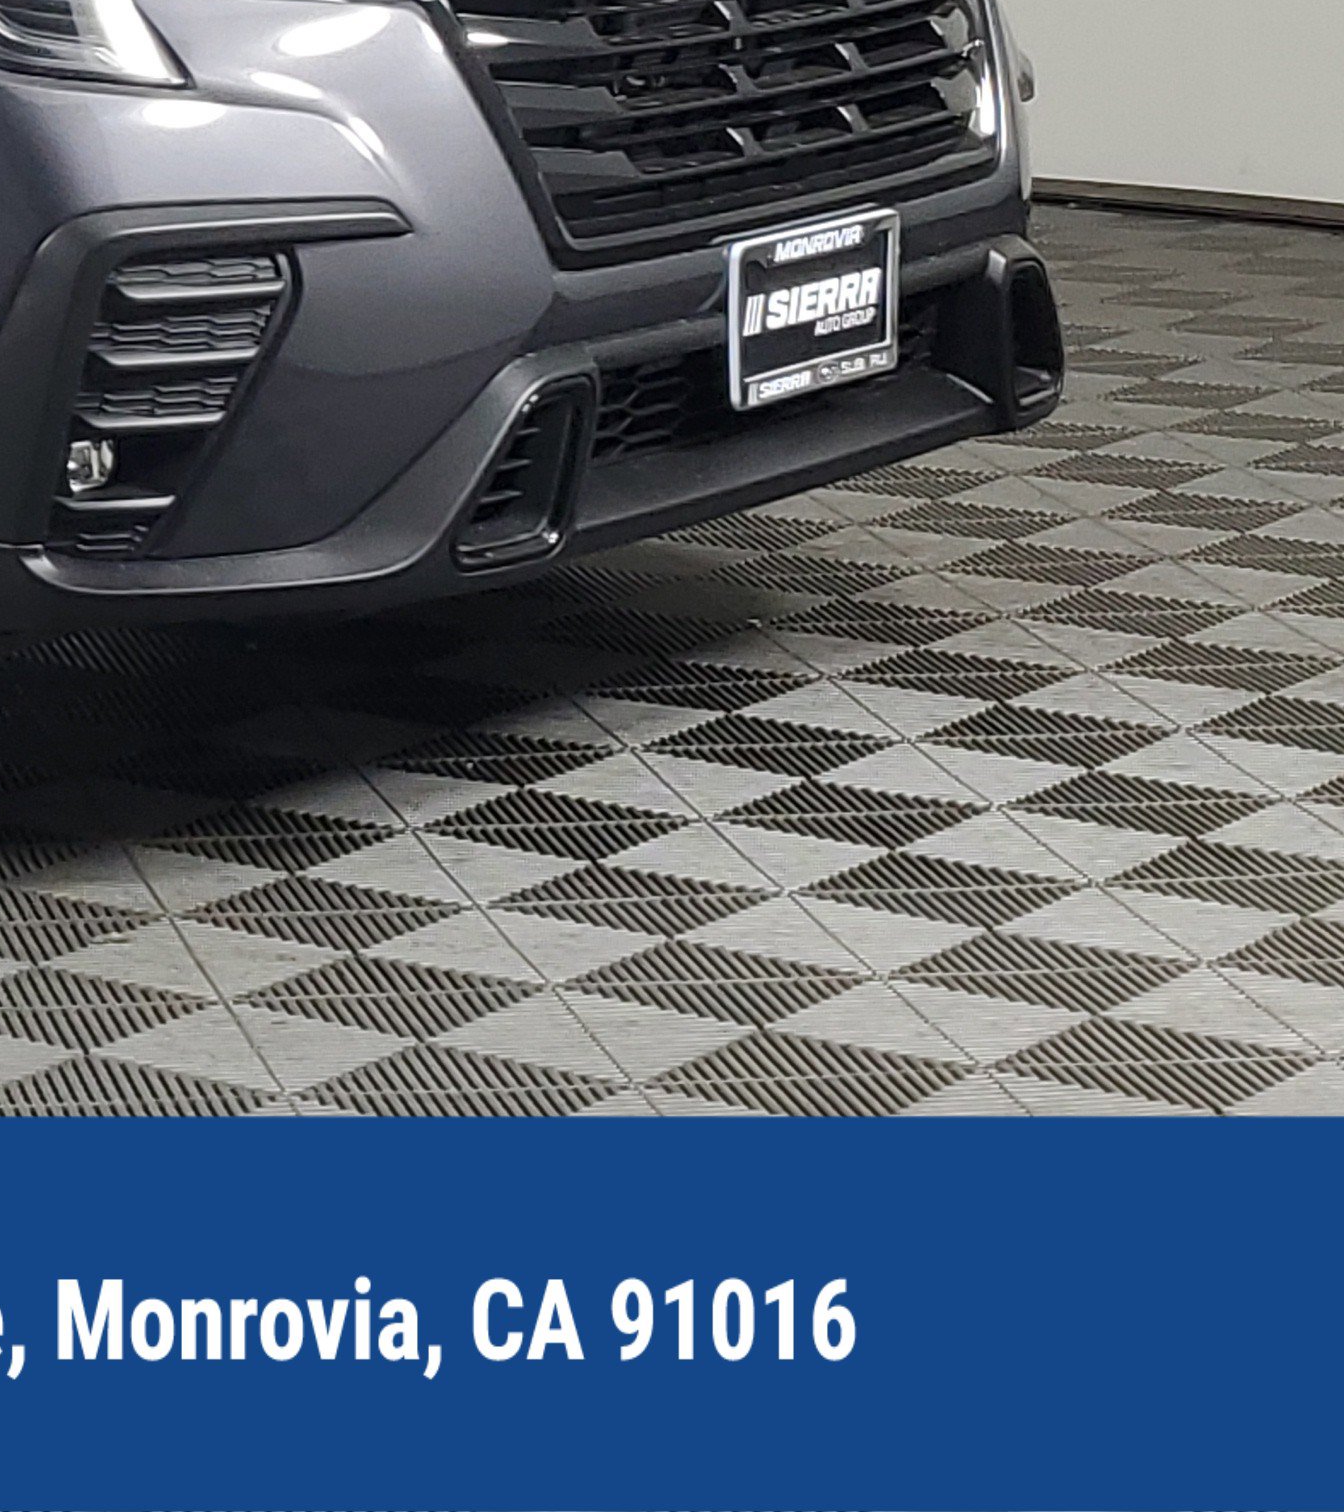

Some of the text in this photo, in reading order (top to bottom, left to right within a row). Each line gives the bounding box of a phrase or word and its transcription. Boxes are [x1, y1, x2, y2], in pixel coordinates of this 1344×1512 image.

[774, 224, 864, 262] MONROVIA
[765, 267, 882, 330] SIERRA
[814, 307, 877, 336] AUTO GROUP
